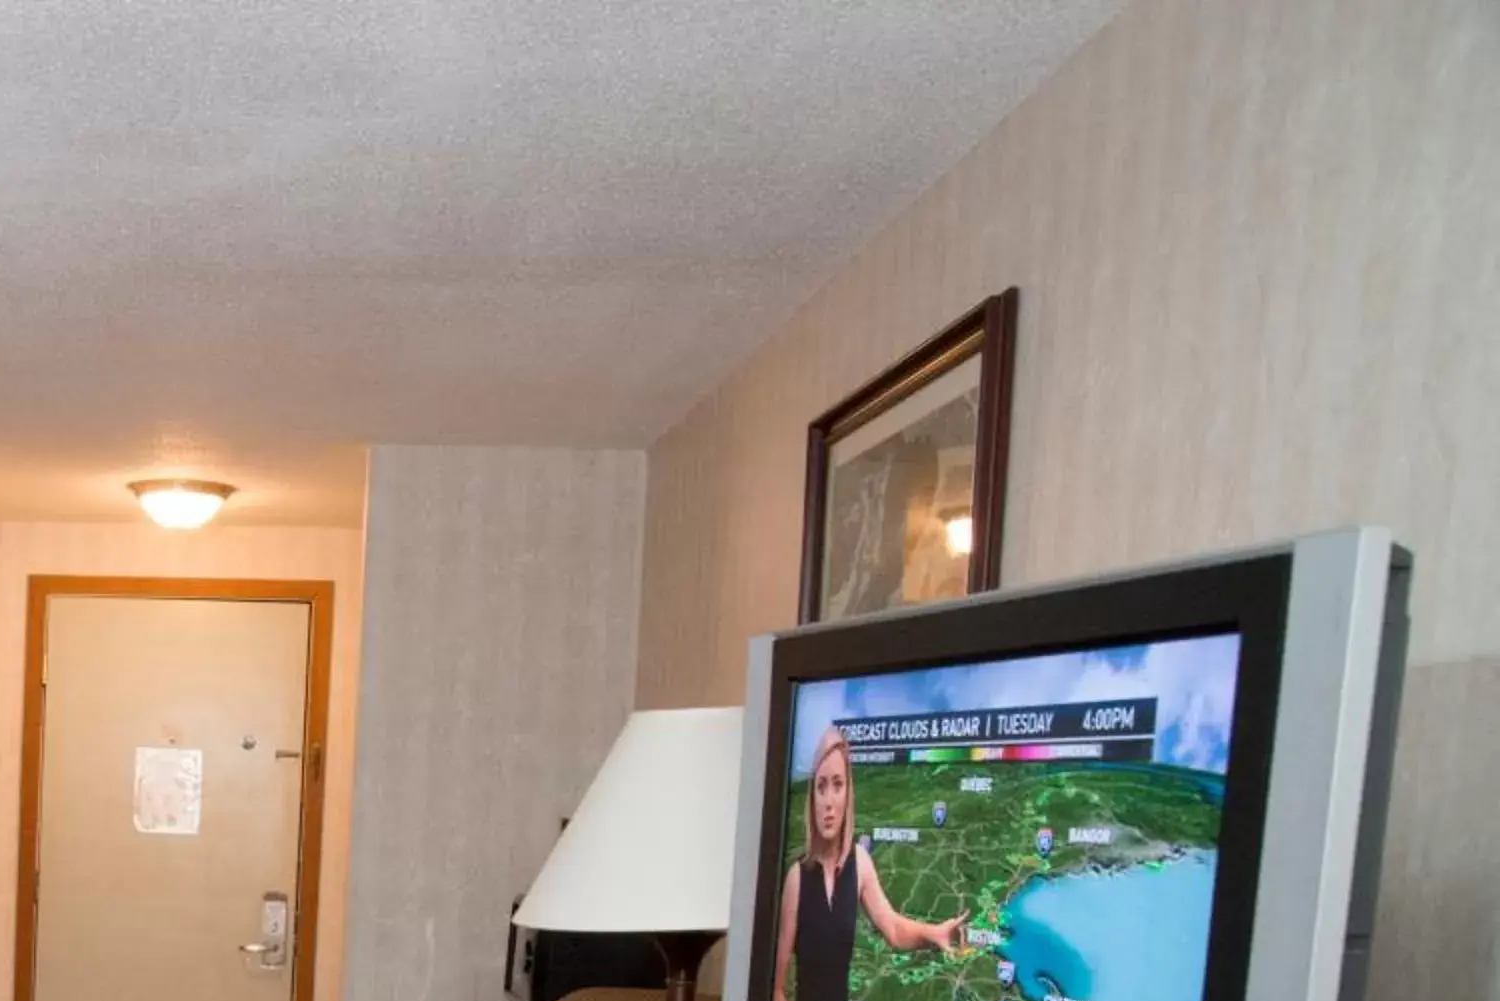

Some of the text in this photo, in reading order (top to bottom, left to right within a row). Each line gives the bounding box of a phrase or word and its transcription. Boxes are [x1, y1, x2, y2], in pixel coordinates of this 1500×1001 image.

[888, 718, 929, 739] CLOUDS
[941, 714, 980, 736] RADAR
[998, 711, 1054, 735] TUESDAY
[1082, 705, 1135, 731] 4:00PM
[1068, 827, 1111, 844] BANGOR
